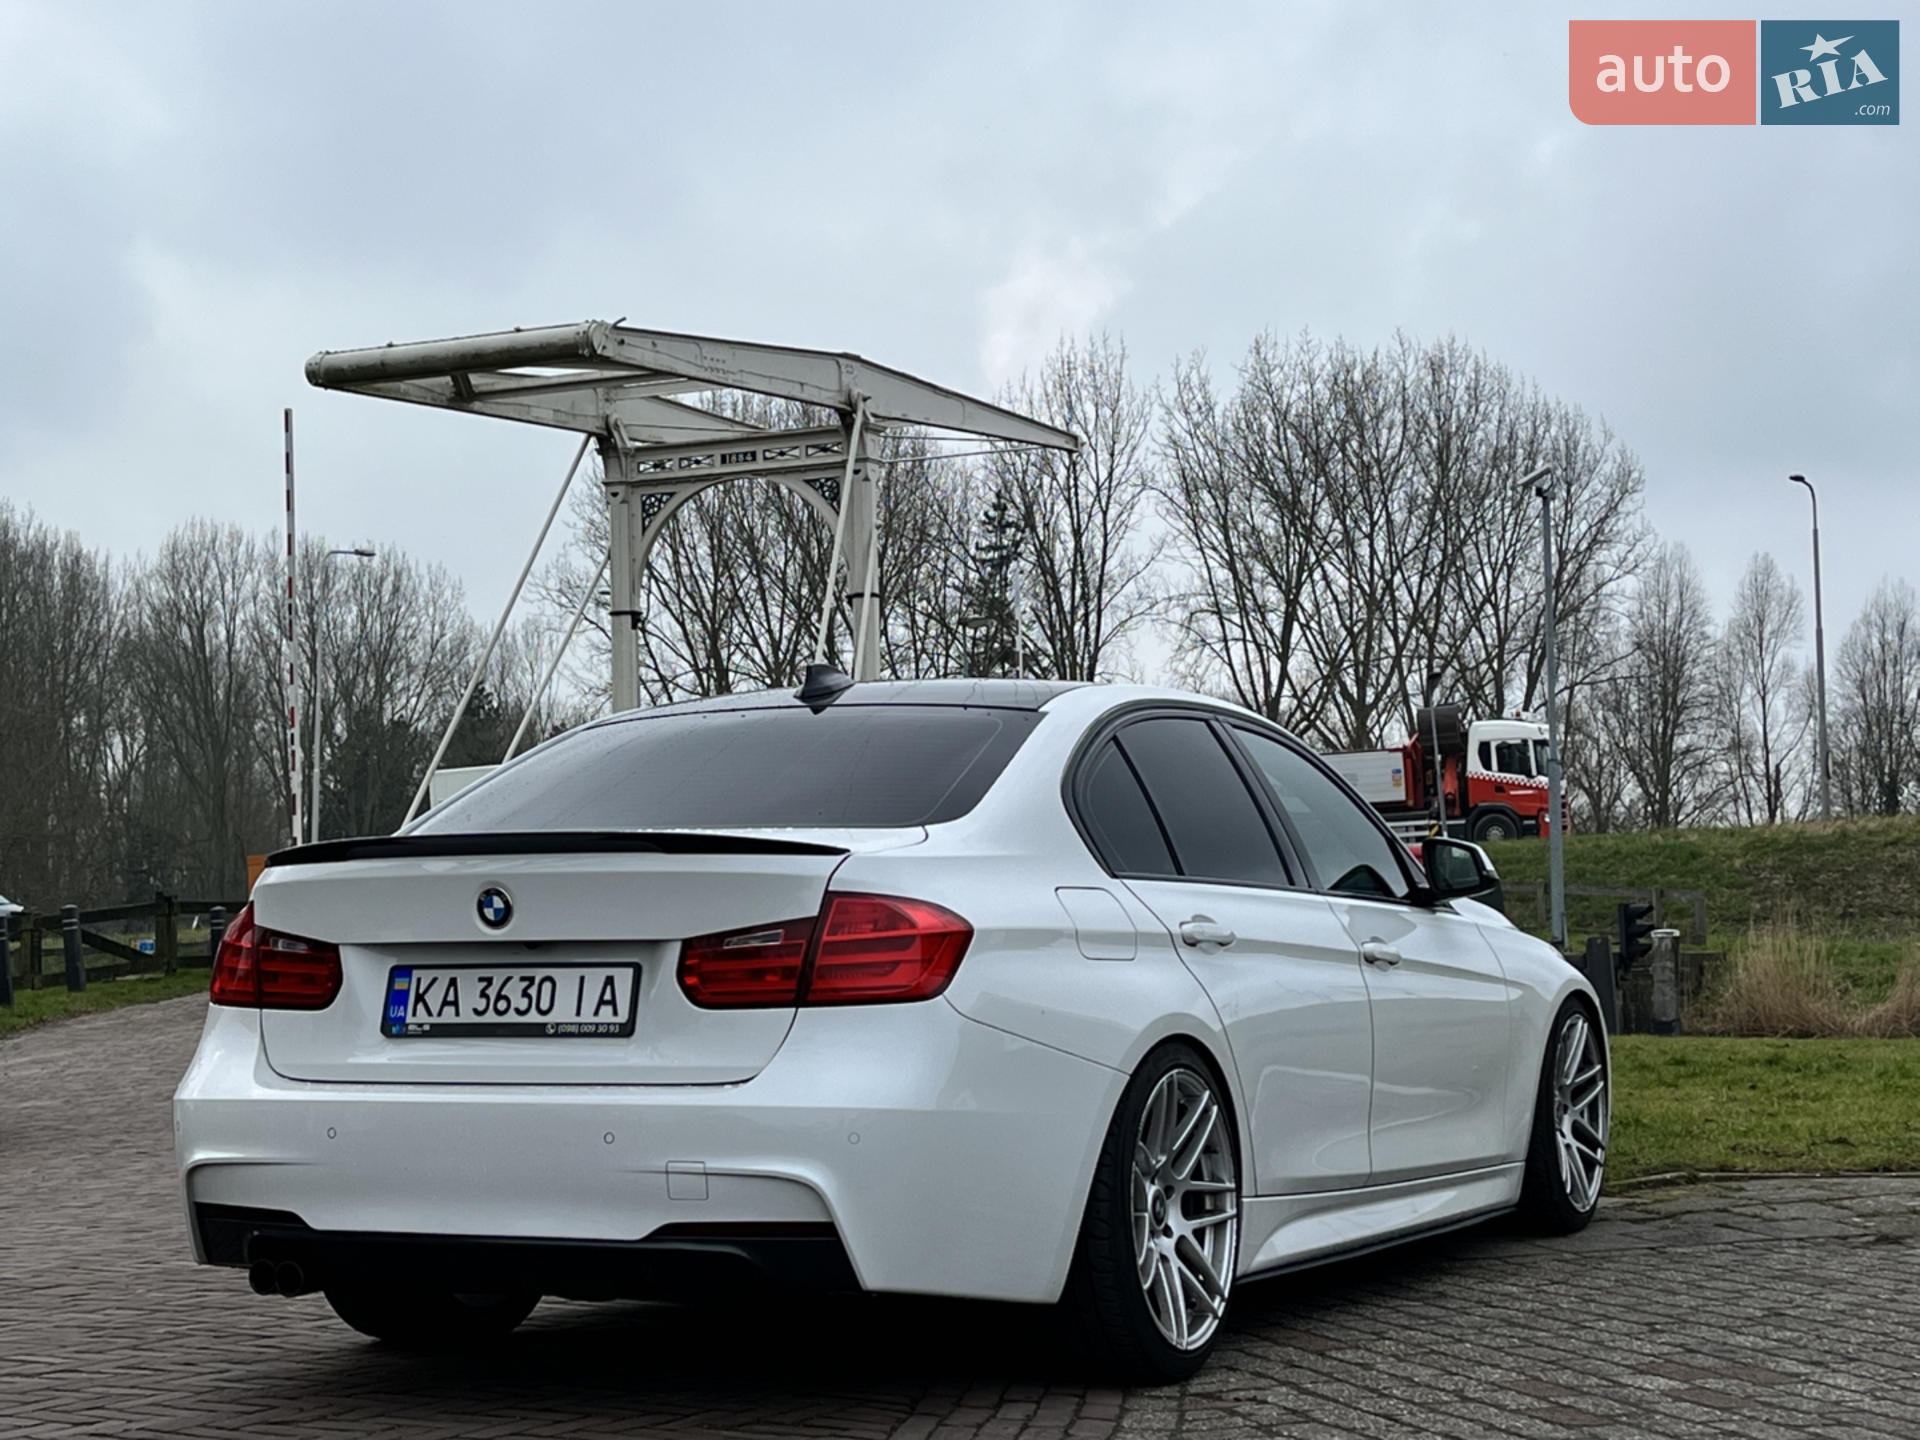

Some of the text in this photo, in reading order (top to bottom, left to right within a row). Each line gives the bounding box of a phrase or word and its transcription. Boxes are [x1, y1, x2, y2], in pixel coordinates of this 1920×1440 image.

[411, 975, 619, 1018] KA 3630 IA
[389, 1005, 405, 1018] UA
